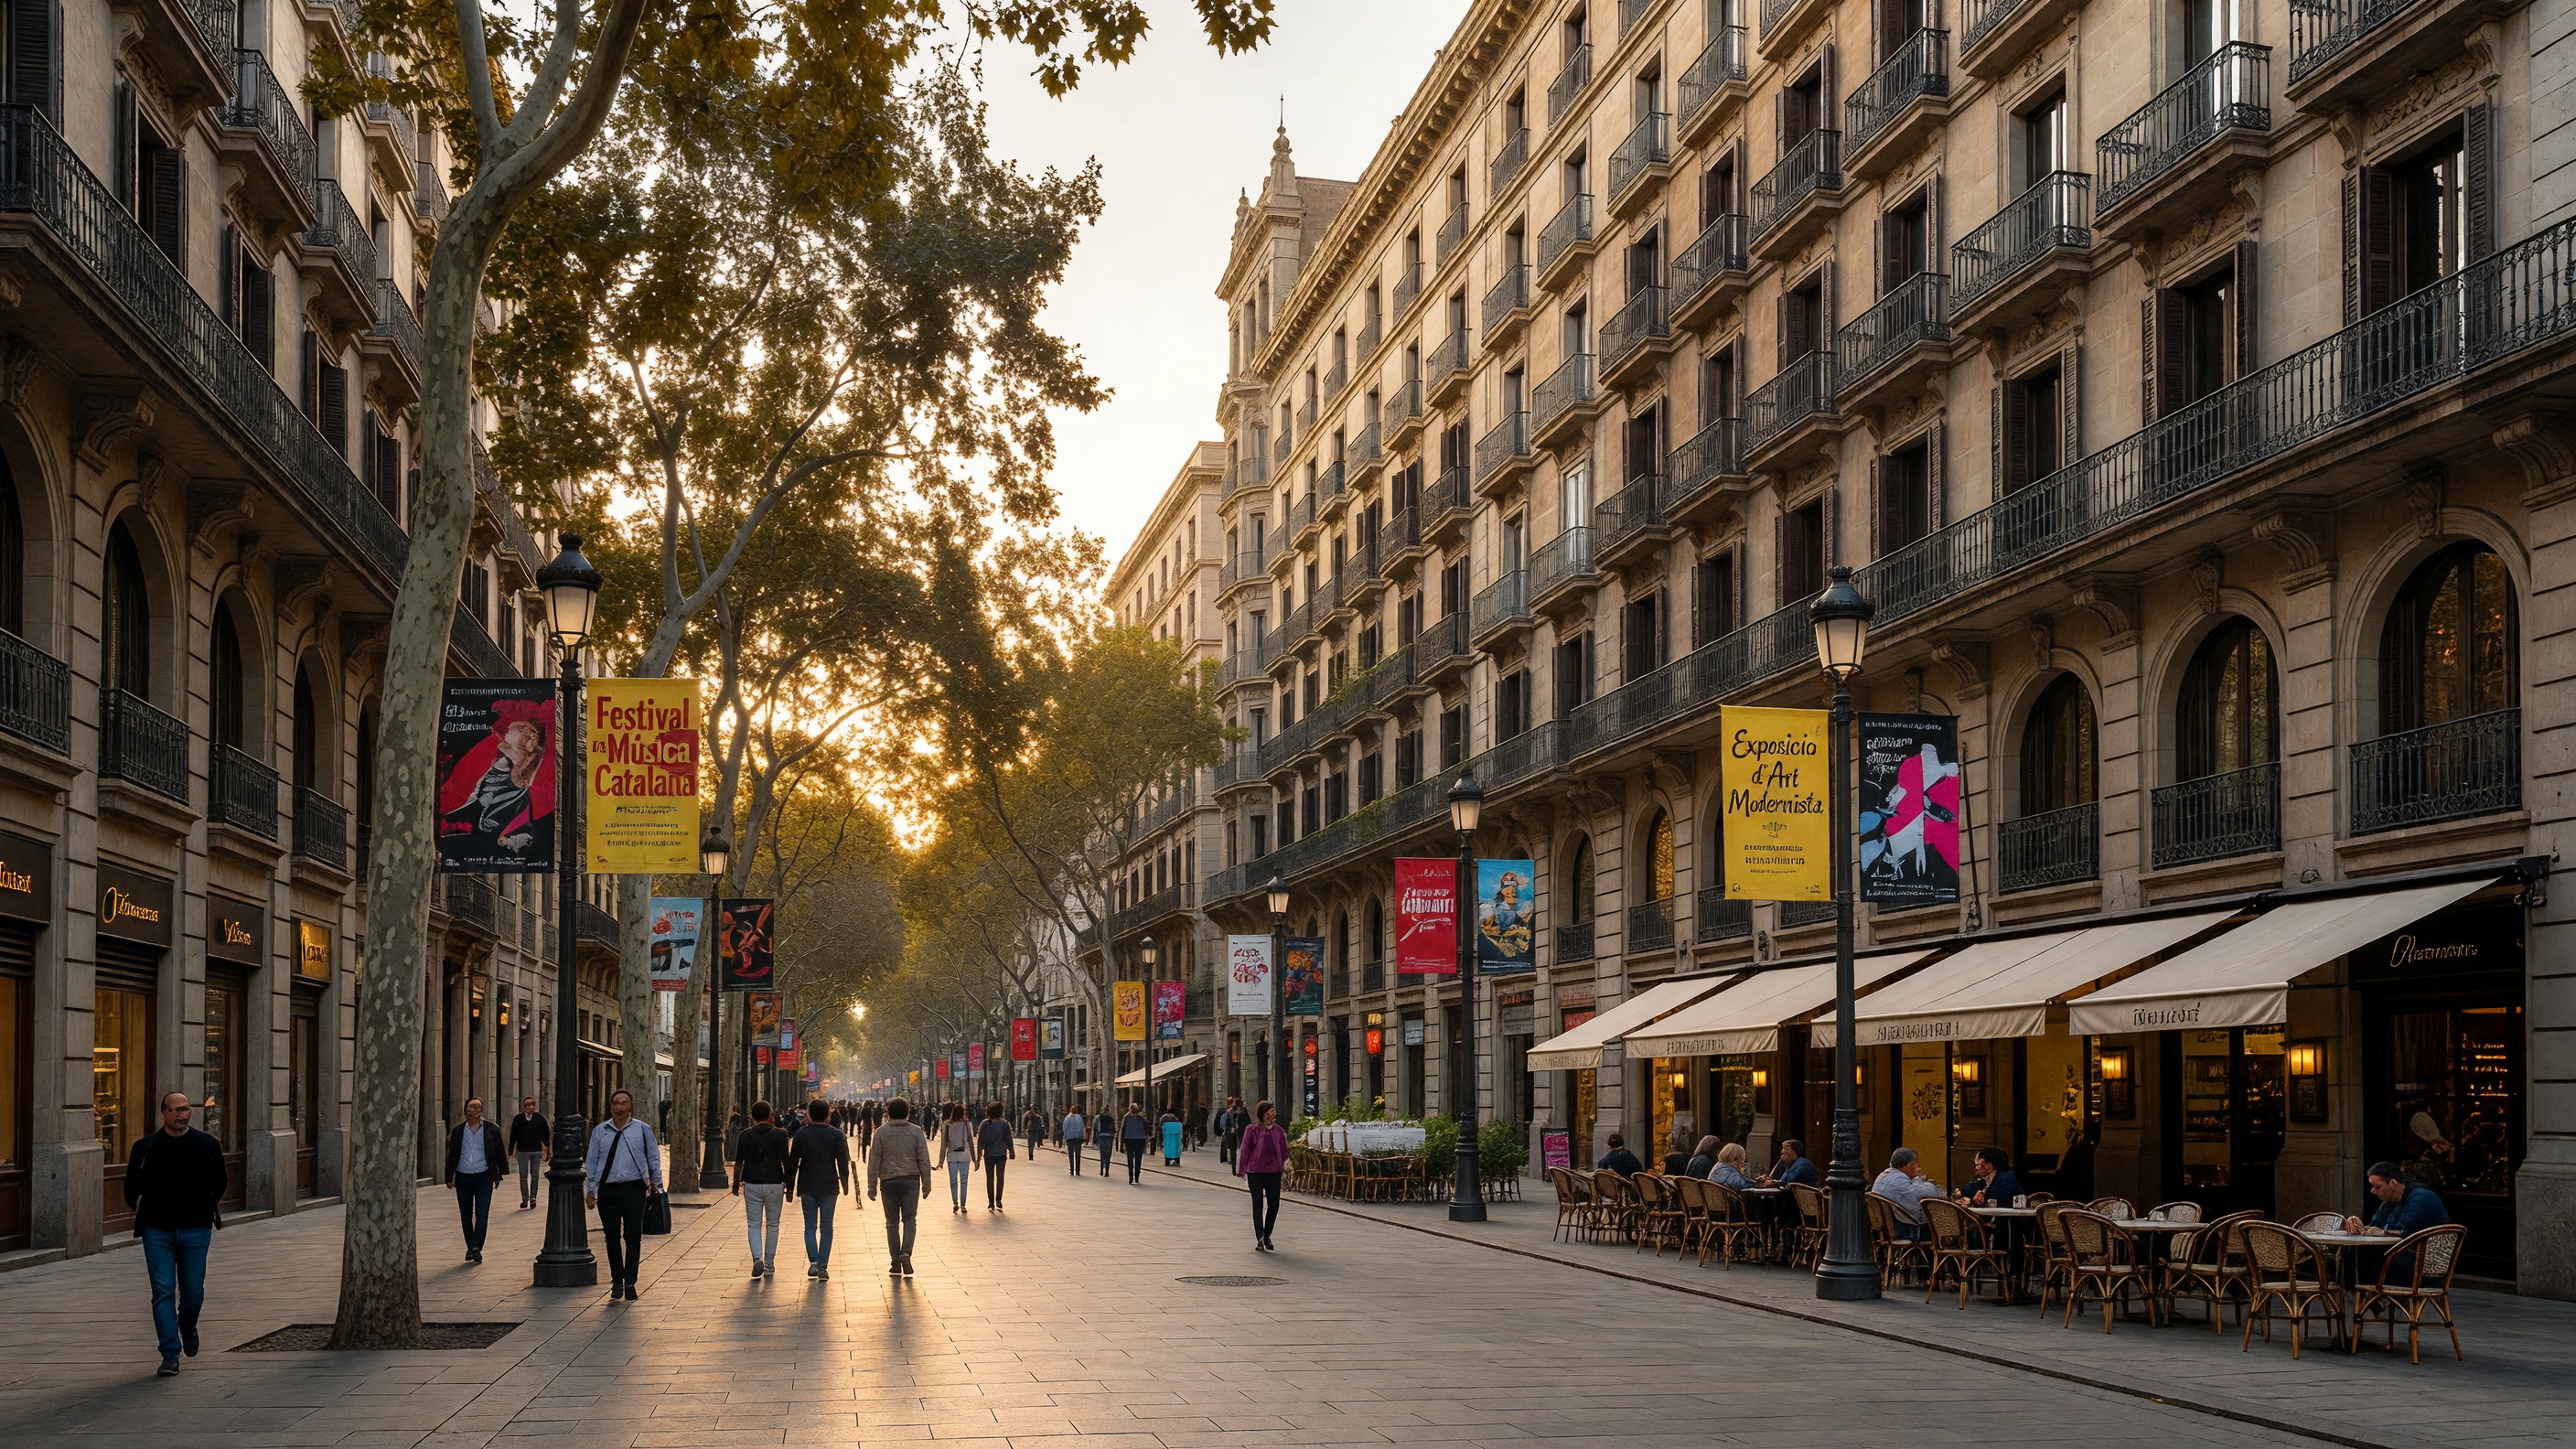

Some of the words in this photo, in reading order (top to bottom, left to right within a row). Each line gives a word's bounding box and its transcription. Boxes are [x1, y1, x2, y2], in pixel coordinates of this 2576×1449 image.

[597, 696, 690, 731] Festival
[607, 733, 691, 765] Música
[595, 764, 696, 797] Catalana
[1728, 788, 1824, 817] Modernista
